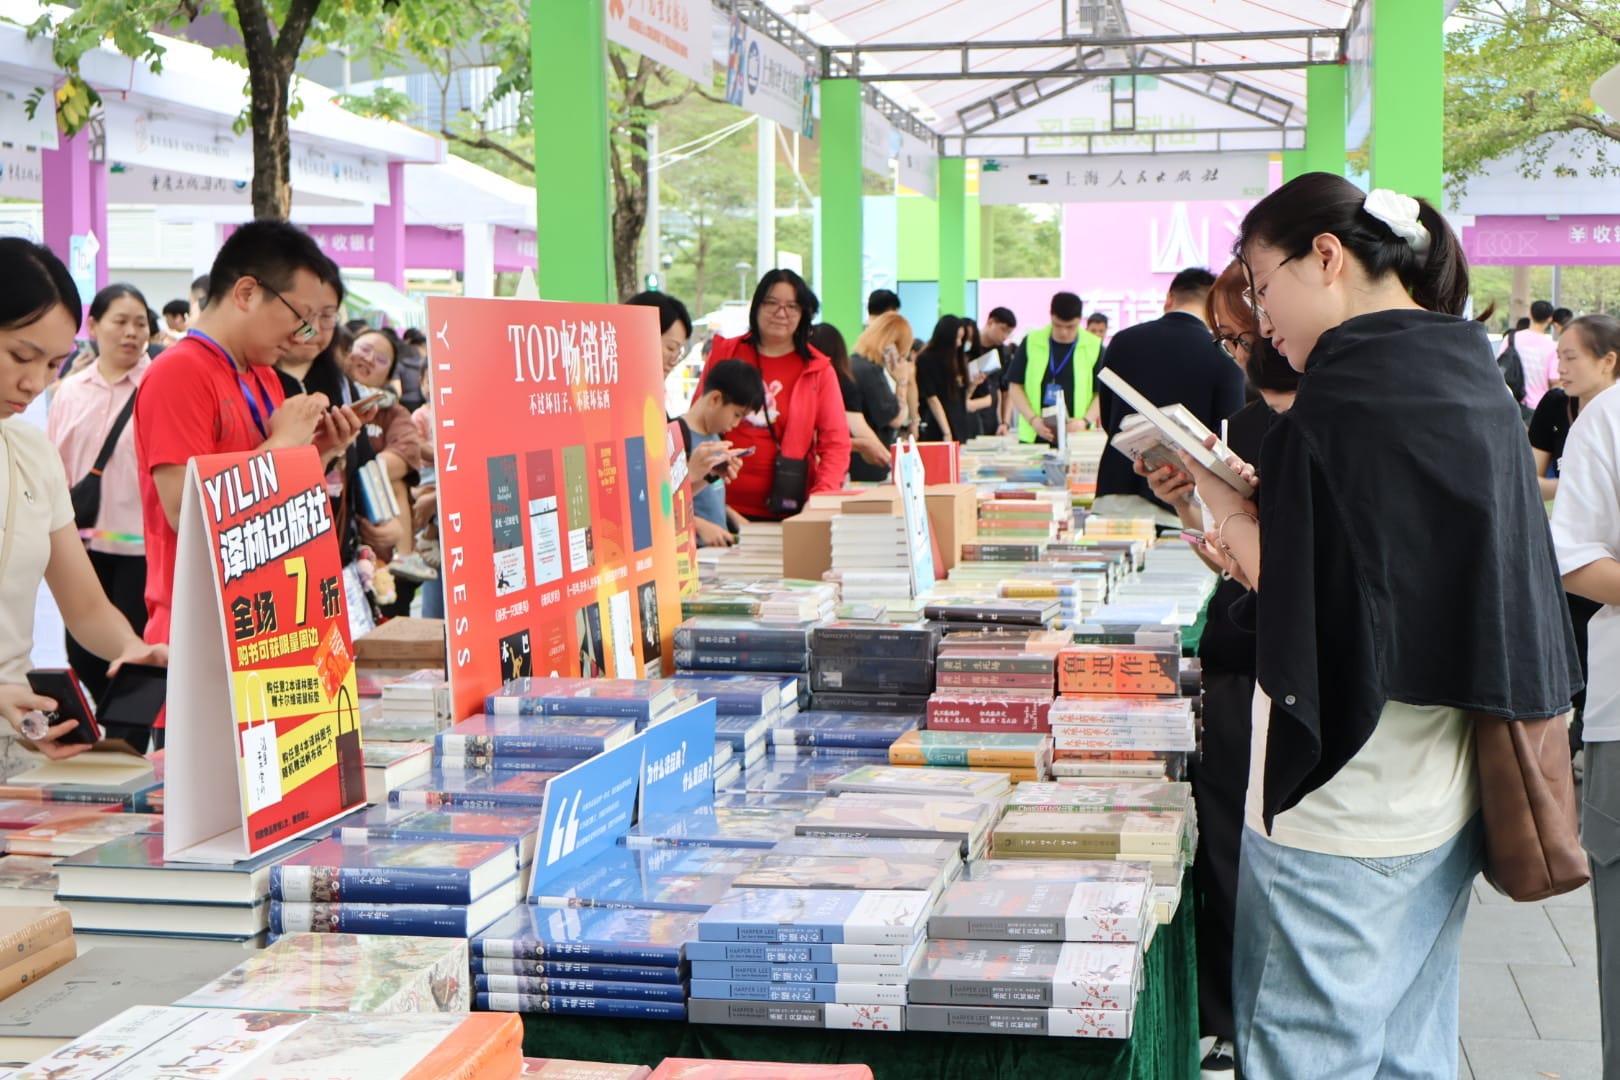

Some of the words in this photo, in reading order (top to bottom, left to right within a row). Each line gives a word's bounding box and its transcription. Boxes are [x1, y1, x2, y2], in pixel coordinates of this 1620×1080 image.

[1064, 169, 1219, 187] 上海人民出版社
[508, 319, 619, 386] TOP畅销榜
[204, 451, 279, 523] YILIN
[436, 320, 458, 472] YILIN
[448, 511, 471, 668] PRESS
[219, 485, 332, 586] 译林出版社
[231, 591, 278, 641] 全场
[284, 556, 308, 625] 7
[320, 576, 342, 619] 折
[237, 631, 320, 667] 购书可获限量周边
